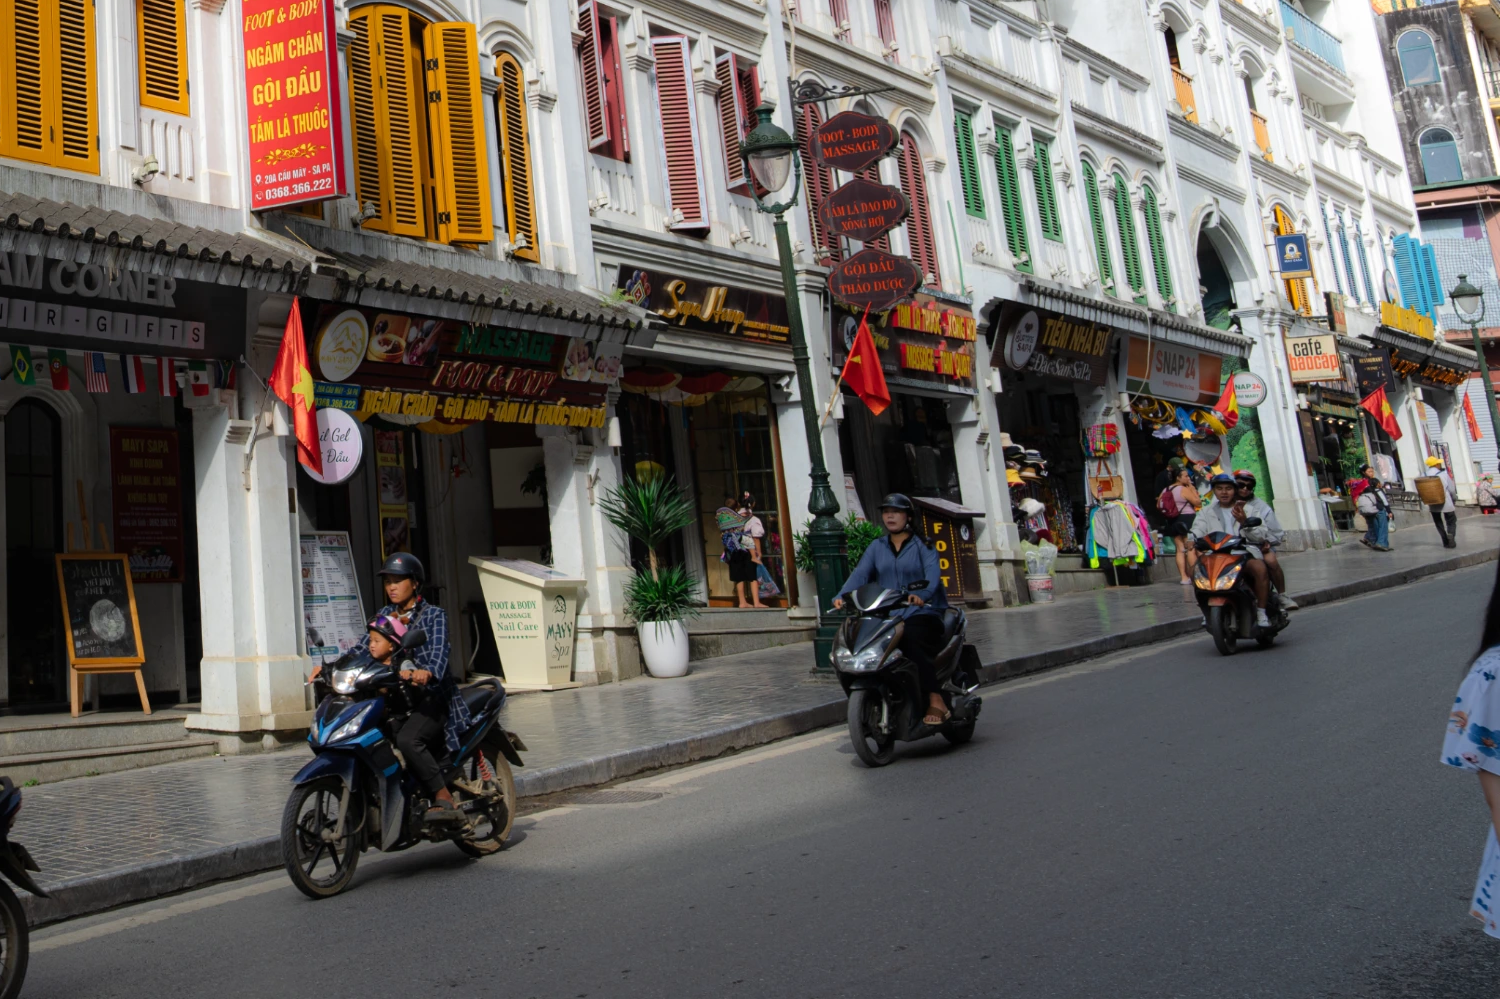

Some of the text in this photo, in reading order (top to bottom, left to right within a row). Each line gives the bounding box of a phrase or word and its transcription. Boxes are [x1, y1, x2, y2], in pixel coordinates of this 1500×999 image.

[245, 9, 274, 32] FOOT
[276, 7, 287, 24] &
[246, 30, 323, 70] NGÂM CHÂN
[252, 77, 281, 108] GỘI
[277, 113, 291, 139] LÁ
[292, 103, 328, 135] THUỐC
[817, 129, 845, 144] FOOT
[852, 124, 880, 139] BODY
[822, 139, 880, 159] MASSAGE
[264, 174, 277, 185] 20A
[312, 164, 321, 175] SA
[322, 162, 331, 173] PA
[265, 178, 333, 200] 0368.366.222
[846, 200, 860, 216] LÁ
[860, 200, 882, 213] DAO
[841, 217, 867, 231] XÔNG
[843, 260, 867, 279] GỘI
[49, 259, 177, 309] CORNER
[656, 278, 747, 335] Sapa Hemp
[456, 325, 555, 363] MASSAGE
[1292, 337, 1323, 357] café
[904, 343, 935, 372] MASSAGE
[431, 360, 558, 396] FOOT & BODY
[361, 386, 403, 415] NGÂM
[402, 390, 438, 417] CHÂN
[319, 427, 351, 442] il Gel
[122, 438, 169, 454] MAYY SAPA
[489, 600, 537, 611] FOOT & BODY
[497, 622, 539, 632] Nail Care
[551, 641, 571, 662] Spa
